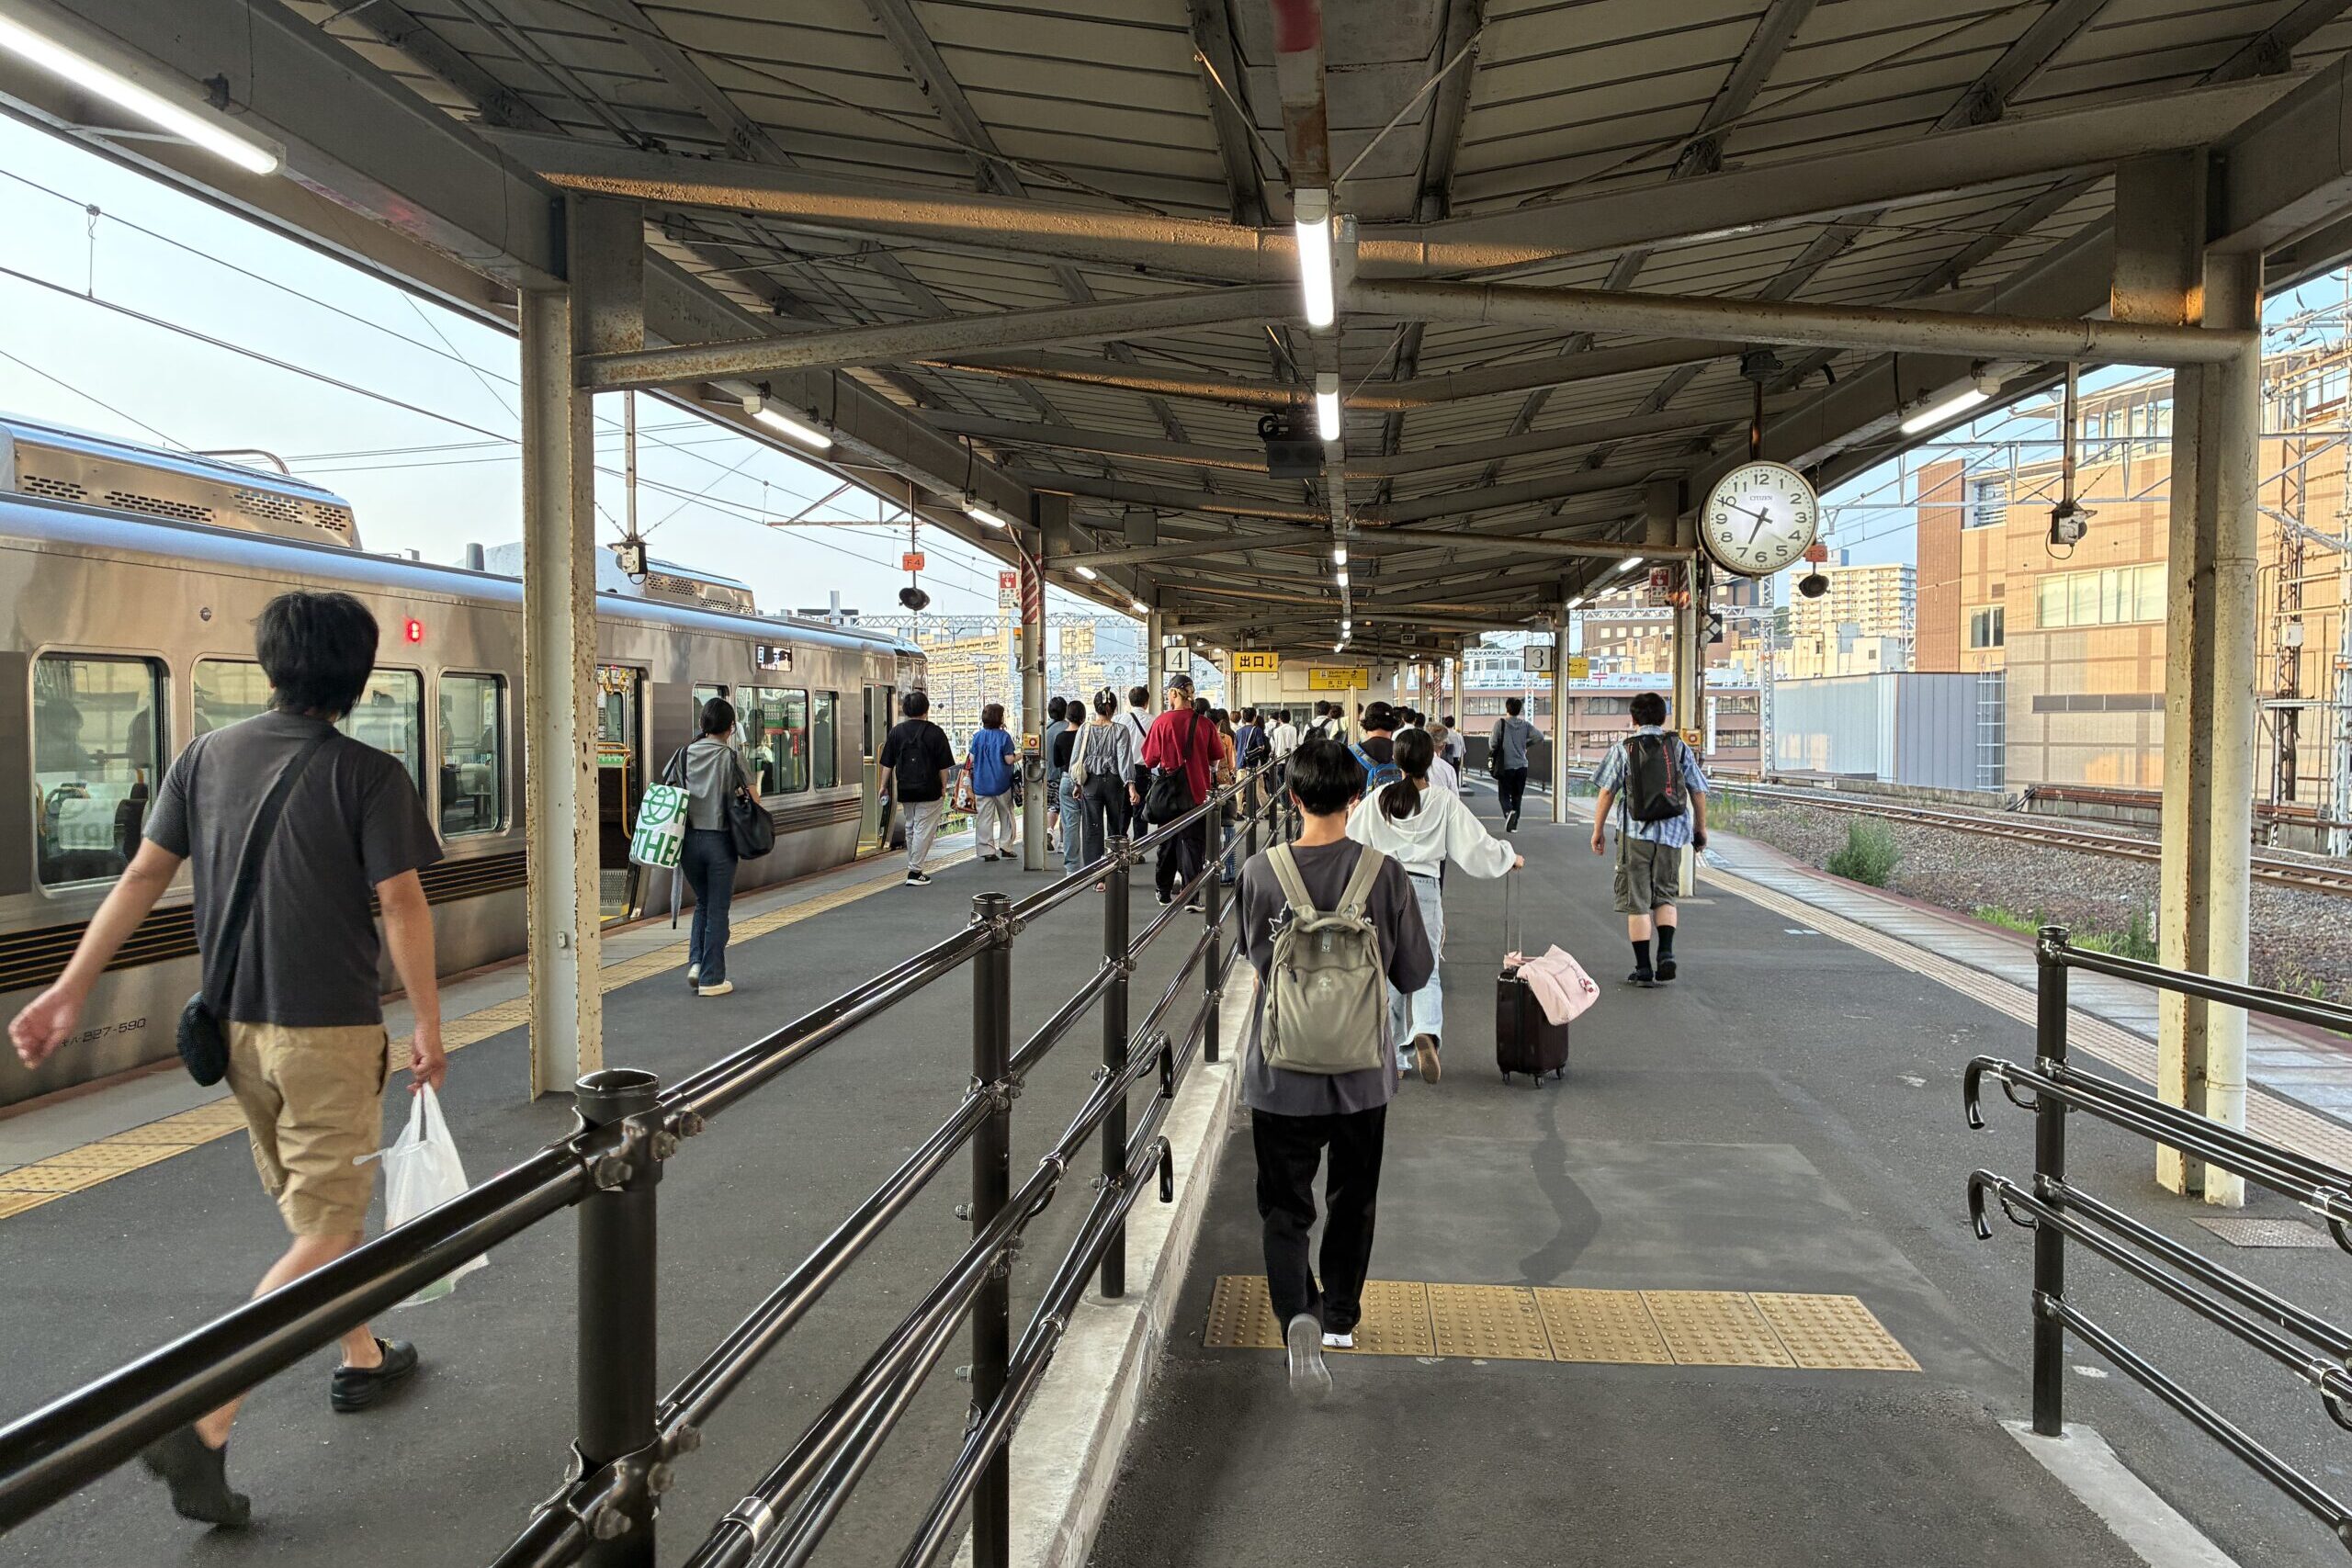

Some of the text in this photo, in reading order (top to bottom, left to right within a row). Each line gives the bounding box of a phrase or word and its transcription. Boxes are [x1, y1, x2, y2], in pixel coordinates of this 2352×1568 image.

[1753, 474, 1770, 486] 12
[1779, 478, 1784, 490] 1
[1733, 481, 1747, 492] 11
[1720, 495, 1737, 507] 10
[1790, 493, 1802, 505] 2
[1715, 513, 1728, 525] 9
[1794, 512, 1808, 524] 3
[1720, 531, 1734, 543] 8
[1788, 529, 1802, 542] 4
[1736, 547, 1749, 558] 7
[1755, 551, 1769, 563] 6
[1775, 545, 1789, 557] 5
[1171, 649, 1183, 669] 4
[1240, 655, 1264, 668] 出口
[1532, 649, 1544, 669] 3
